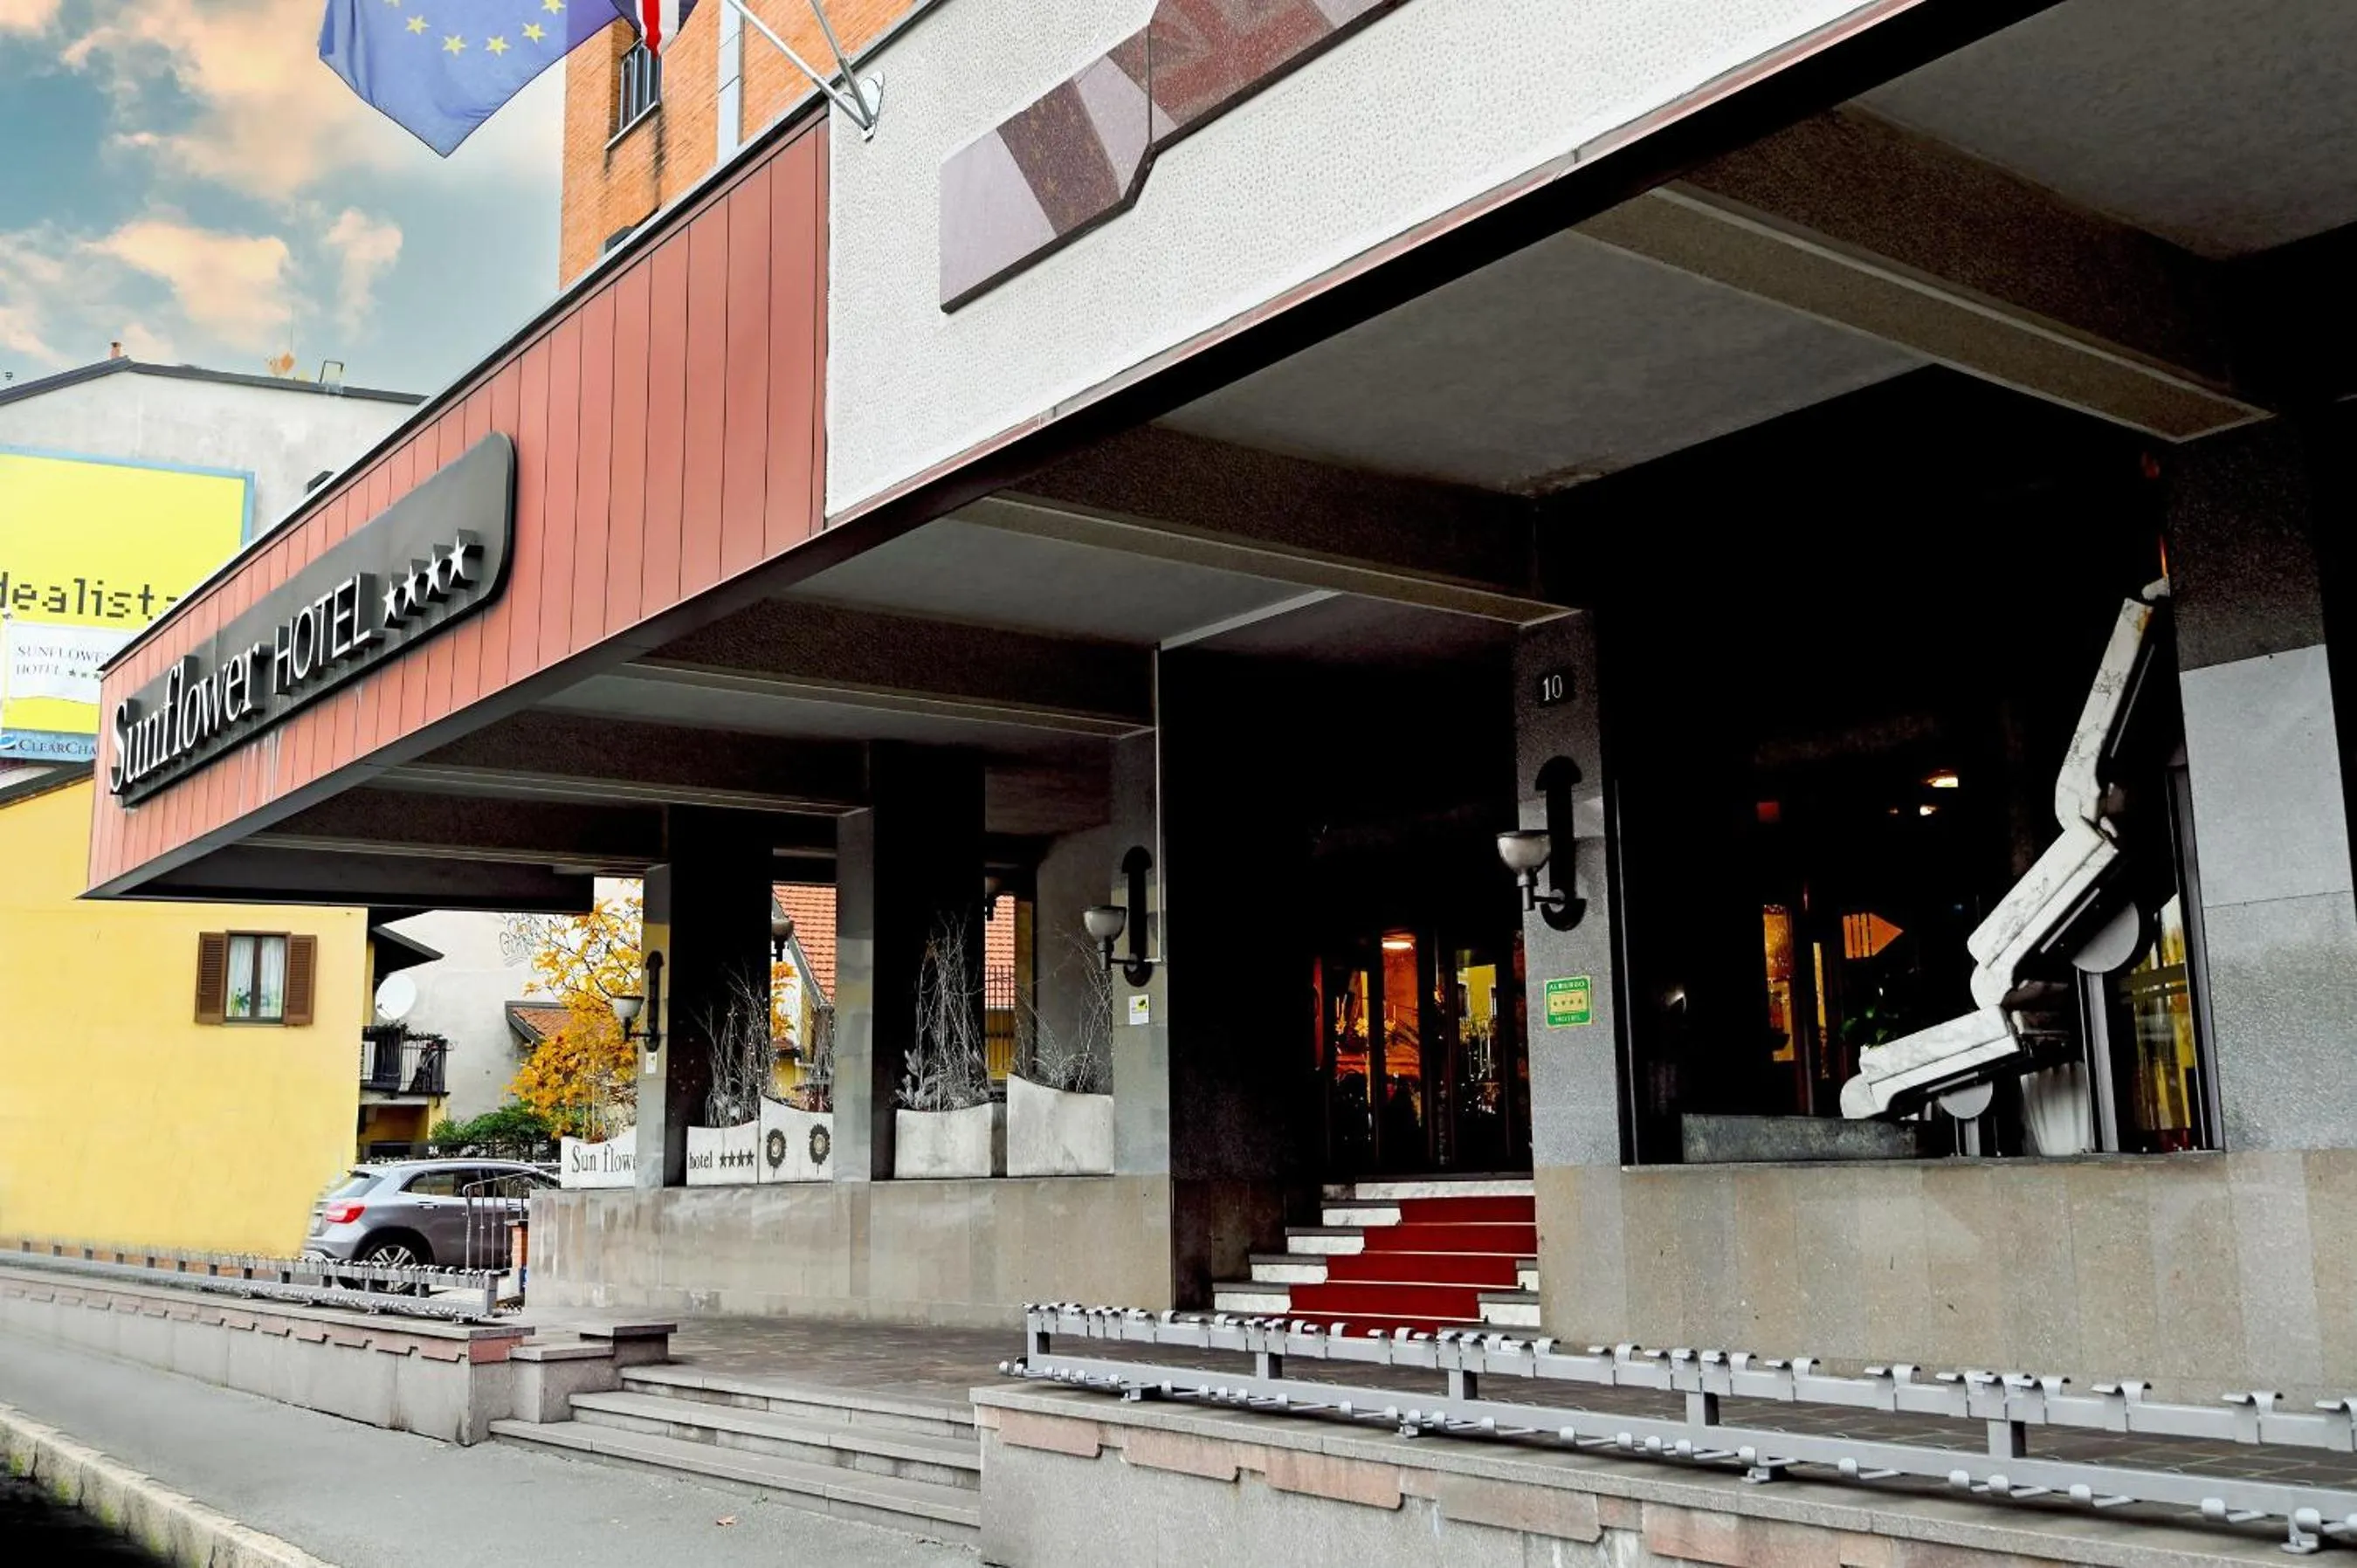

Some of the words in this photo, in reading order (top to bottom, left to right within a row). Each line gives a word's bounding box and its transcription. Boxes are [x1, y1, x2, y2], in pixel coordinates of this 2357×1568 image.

[0, 572, 175, 621] ealist
[110, 643, 261, 792] Sunflower
[273, 573, 371, 694] HOTEL
[1542, 674, 1563, 701] 10
[572, 1145, 596, 1173] Sun
[688, 1150, 713, 1169] hotel
